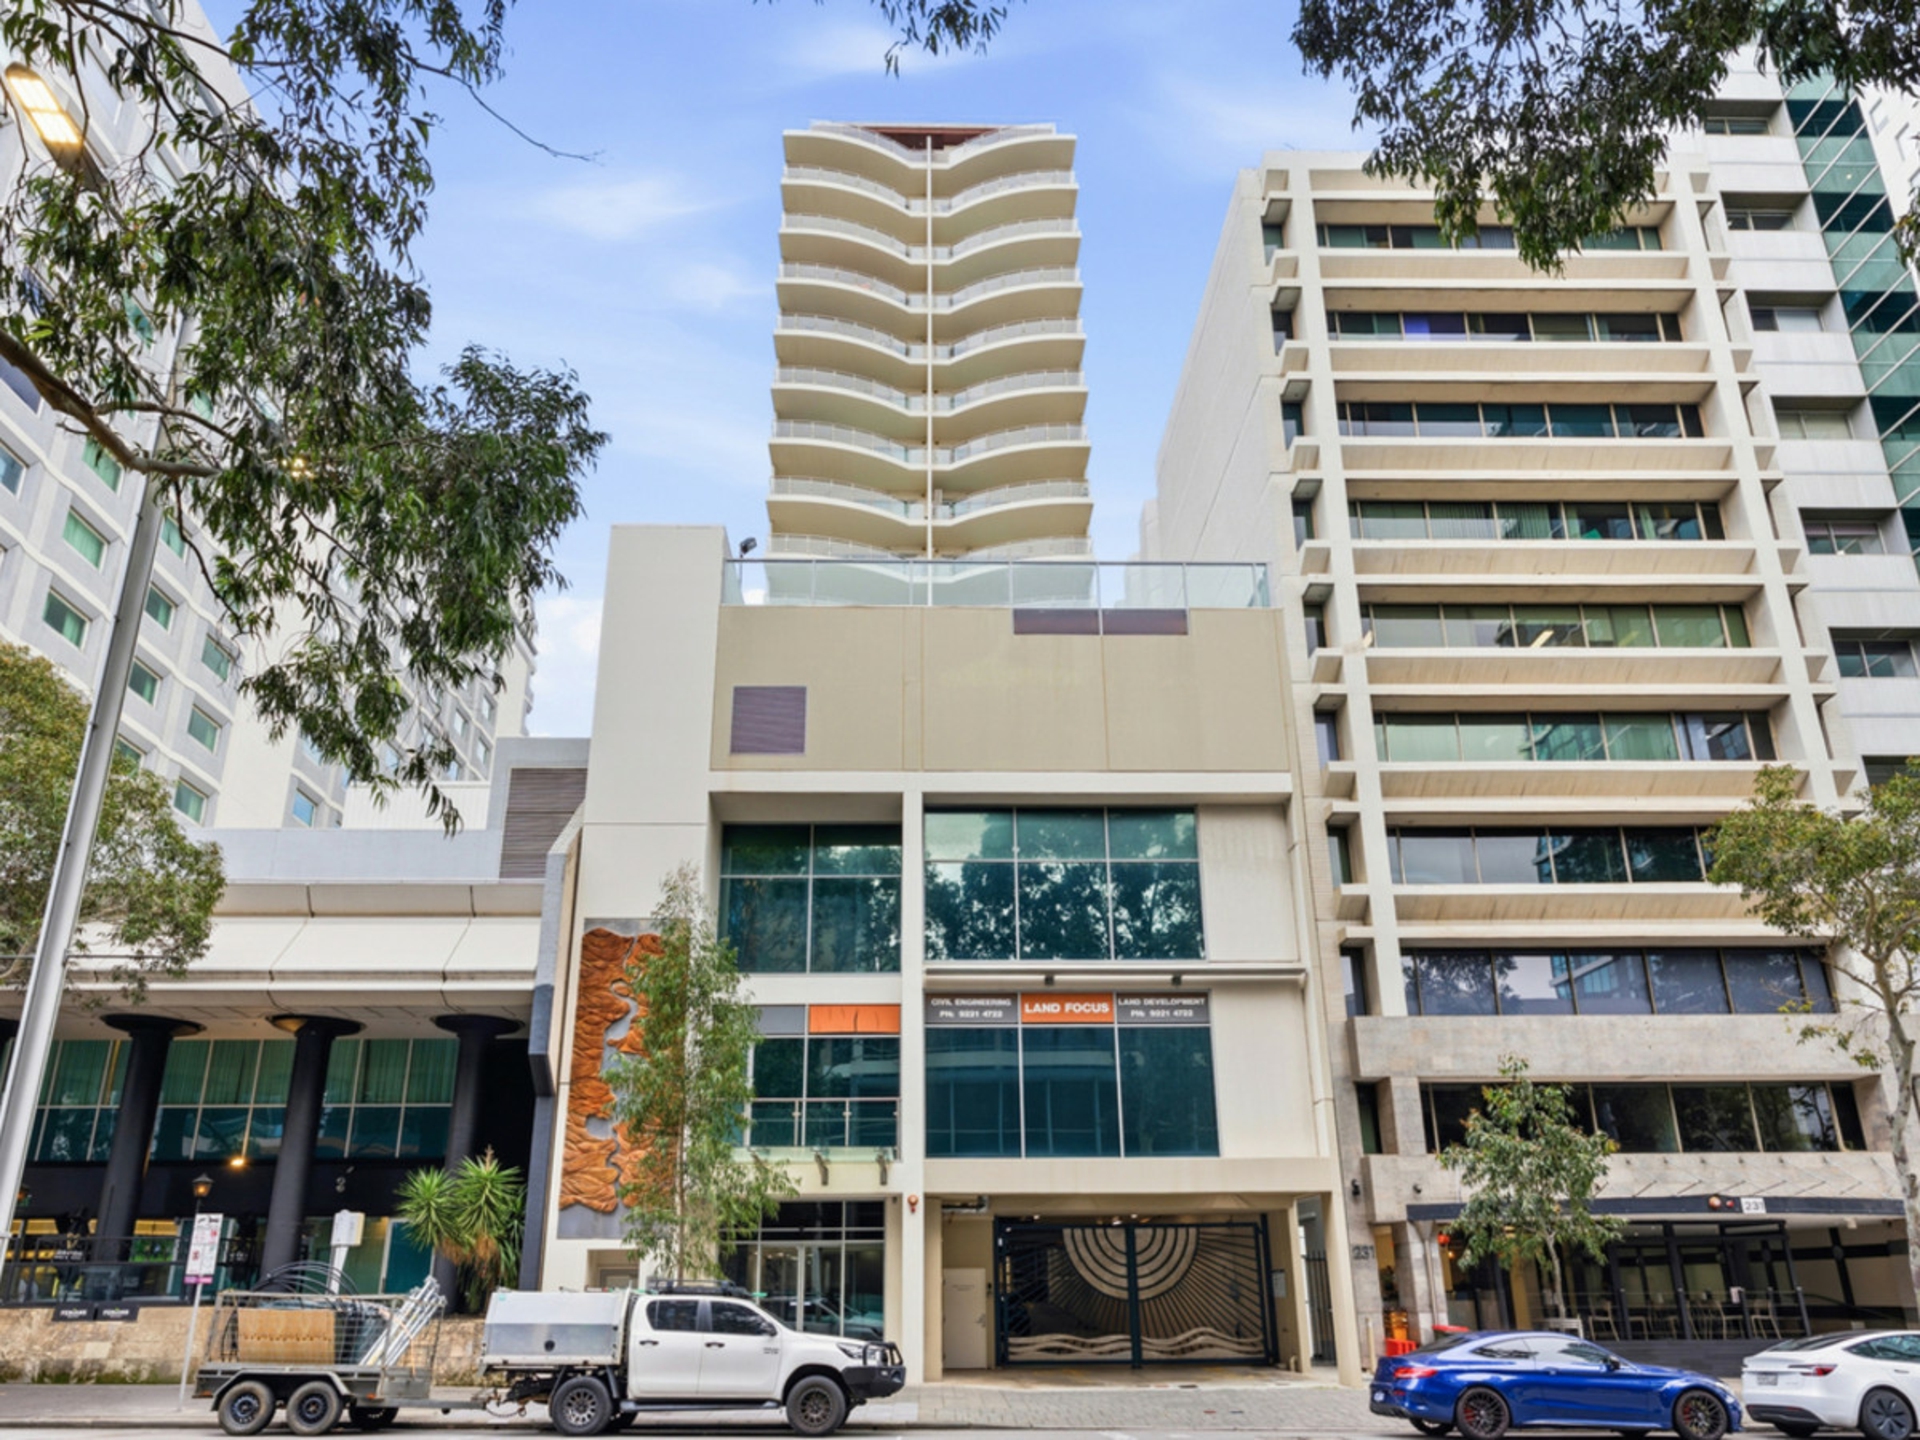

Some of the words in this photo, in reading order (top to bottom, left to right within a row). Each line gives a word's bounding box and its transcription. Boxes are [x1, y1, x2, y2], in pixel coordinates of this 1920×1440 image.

[955, 998, 1012, 1007] ENGINEERING
[1118, 998, 1141, 1006] LAND
[1143, 998, 1206, 1006] DEVELOPMENT
[1024, 1002, 1061, 1014] LAND
[1064, 1002, 1110, 1014] FOCUS
[1744, 1200, 1765, 1211] 231
[1352, 1244, 1375, 1260] 231
